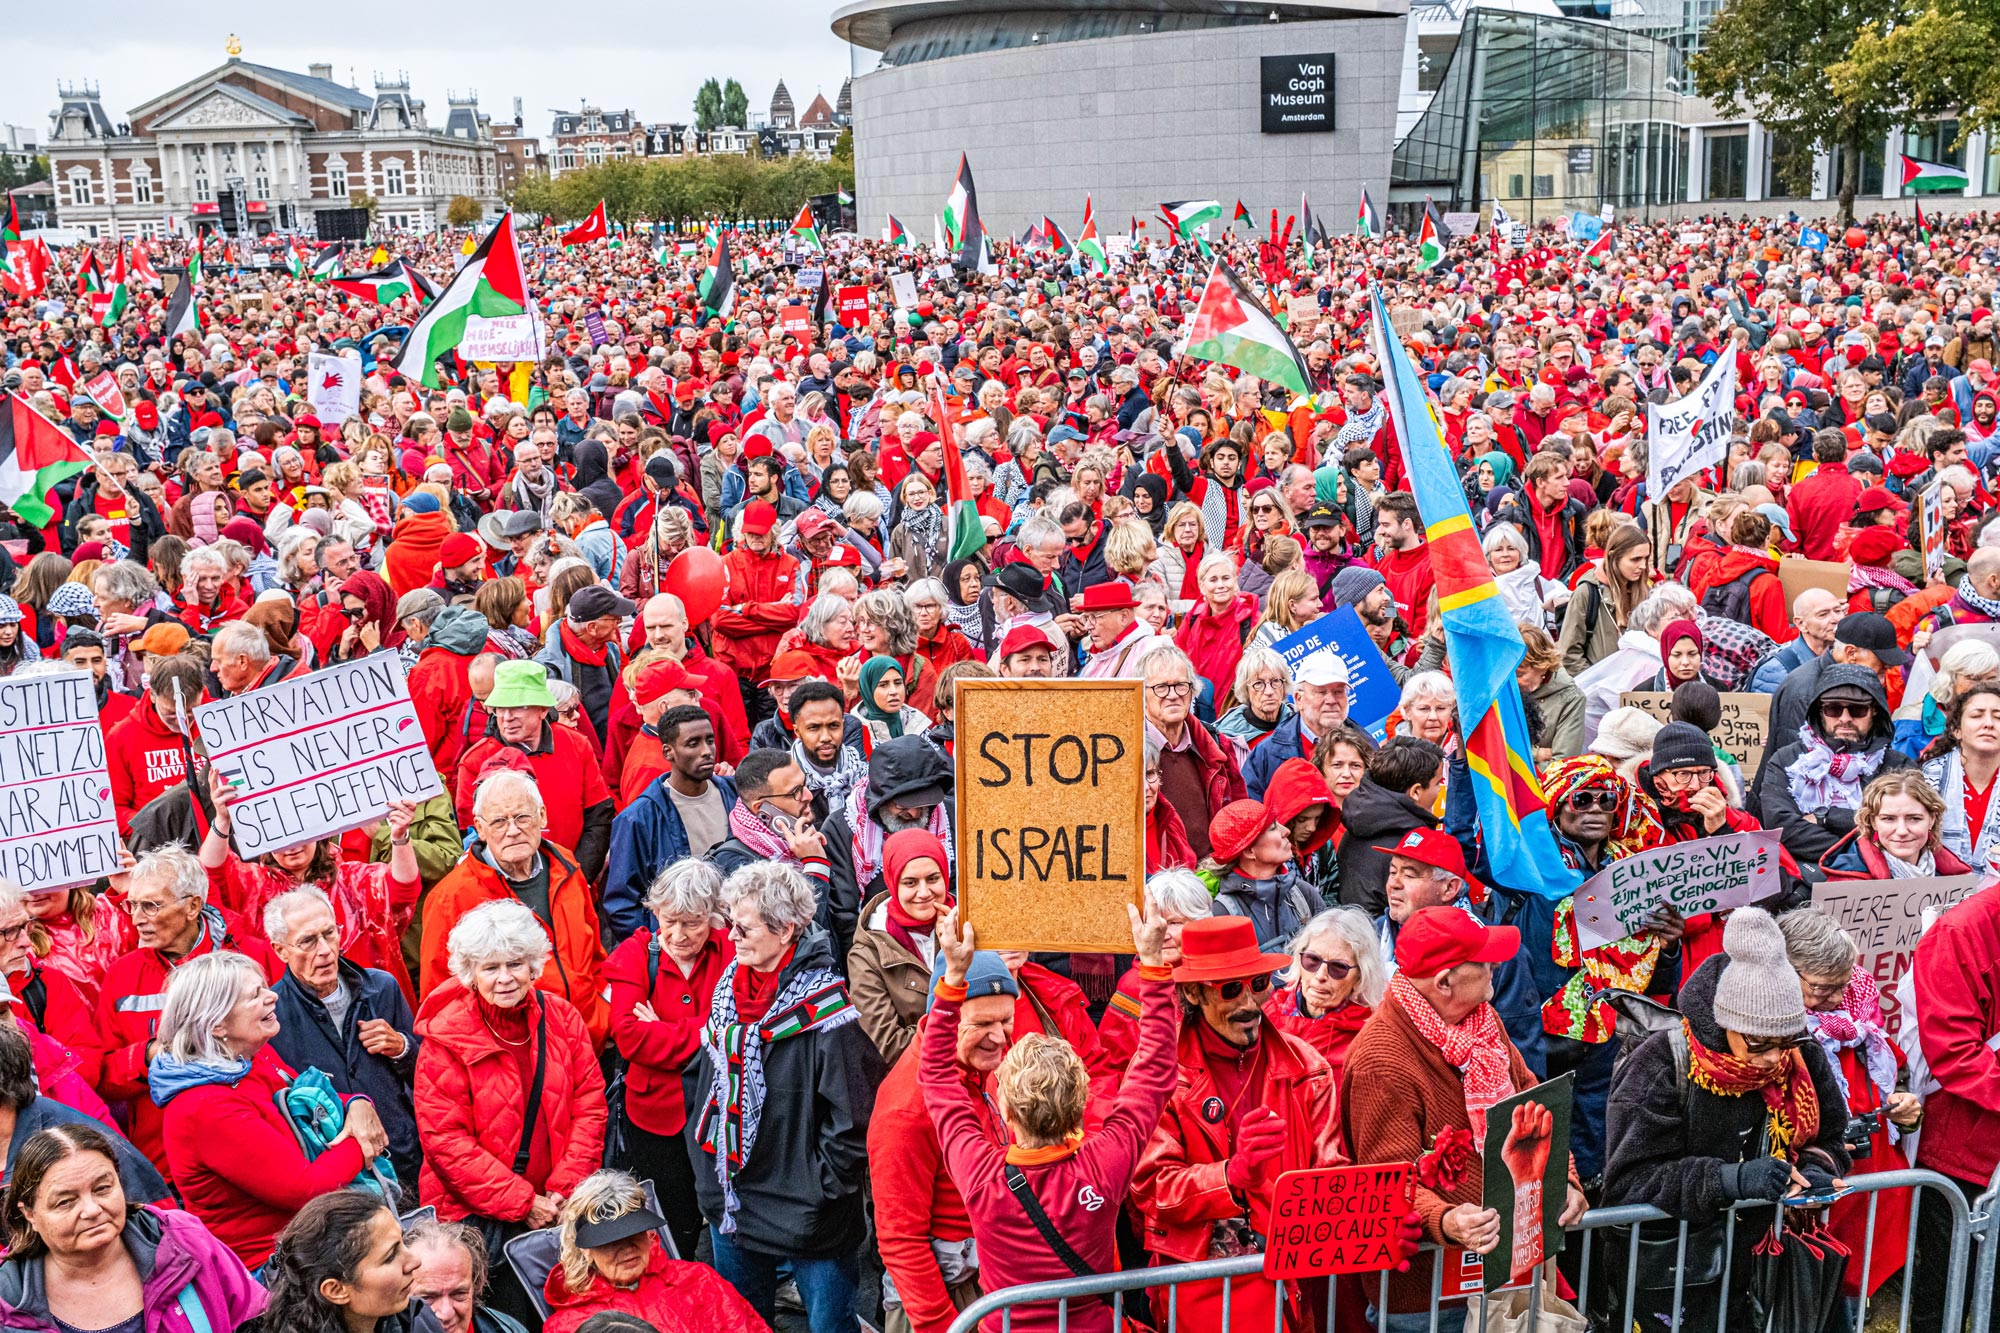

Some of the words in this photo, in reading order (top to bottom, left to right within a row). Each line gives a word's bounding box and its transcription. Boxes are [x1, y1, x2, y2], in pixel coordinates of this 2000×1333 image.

[1288, 78, 1324, 92] Gogh
[1298, 63, 1324, 76] Van
[1270, 94, 1324, 106] Museum
[1281, 113, 1324, 122] Amsterdam
[1512, 230, 1526, 238] HELP
[1659, 411, 1698, 435] FREE
[1305, 635, 1322, 650] DE
[2, 678, 94, 726] STILTE
[201, 662, 396, 748] STARVATION
[16, 730, 65, 780] NET
[71, 726, 103, 772] ZO
[238, 750, 274, 790] IS
[290, 717, 399, 774] NEVER
[1725, 733, 1760, 747] child
[978, 731, 1125, 787] STOP
[58, 778, 102, 826] ALS
[235, 752, 434, 848] SELF-DEFENCE
[15, 831, 119, 887] BOMMEN
[976, 824, 1127, 882] ISRAEL
[1652, 852, 1685, 874] VS
[1690, 854, 1705, 863] en
[1706, 843, 1740, 861] VN
[1824, 894, 1899, 926] THERE
[1273, 1216, 1403, 1246] HOLOCAUST
[1309, 1243, 1392, 1267] GAZA
